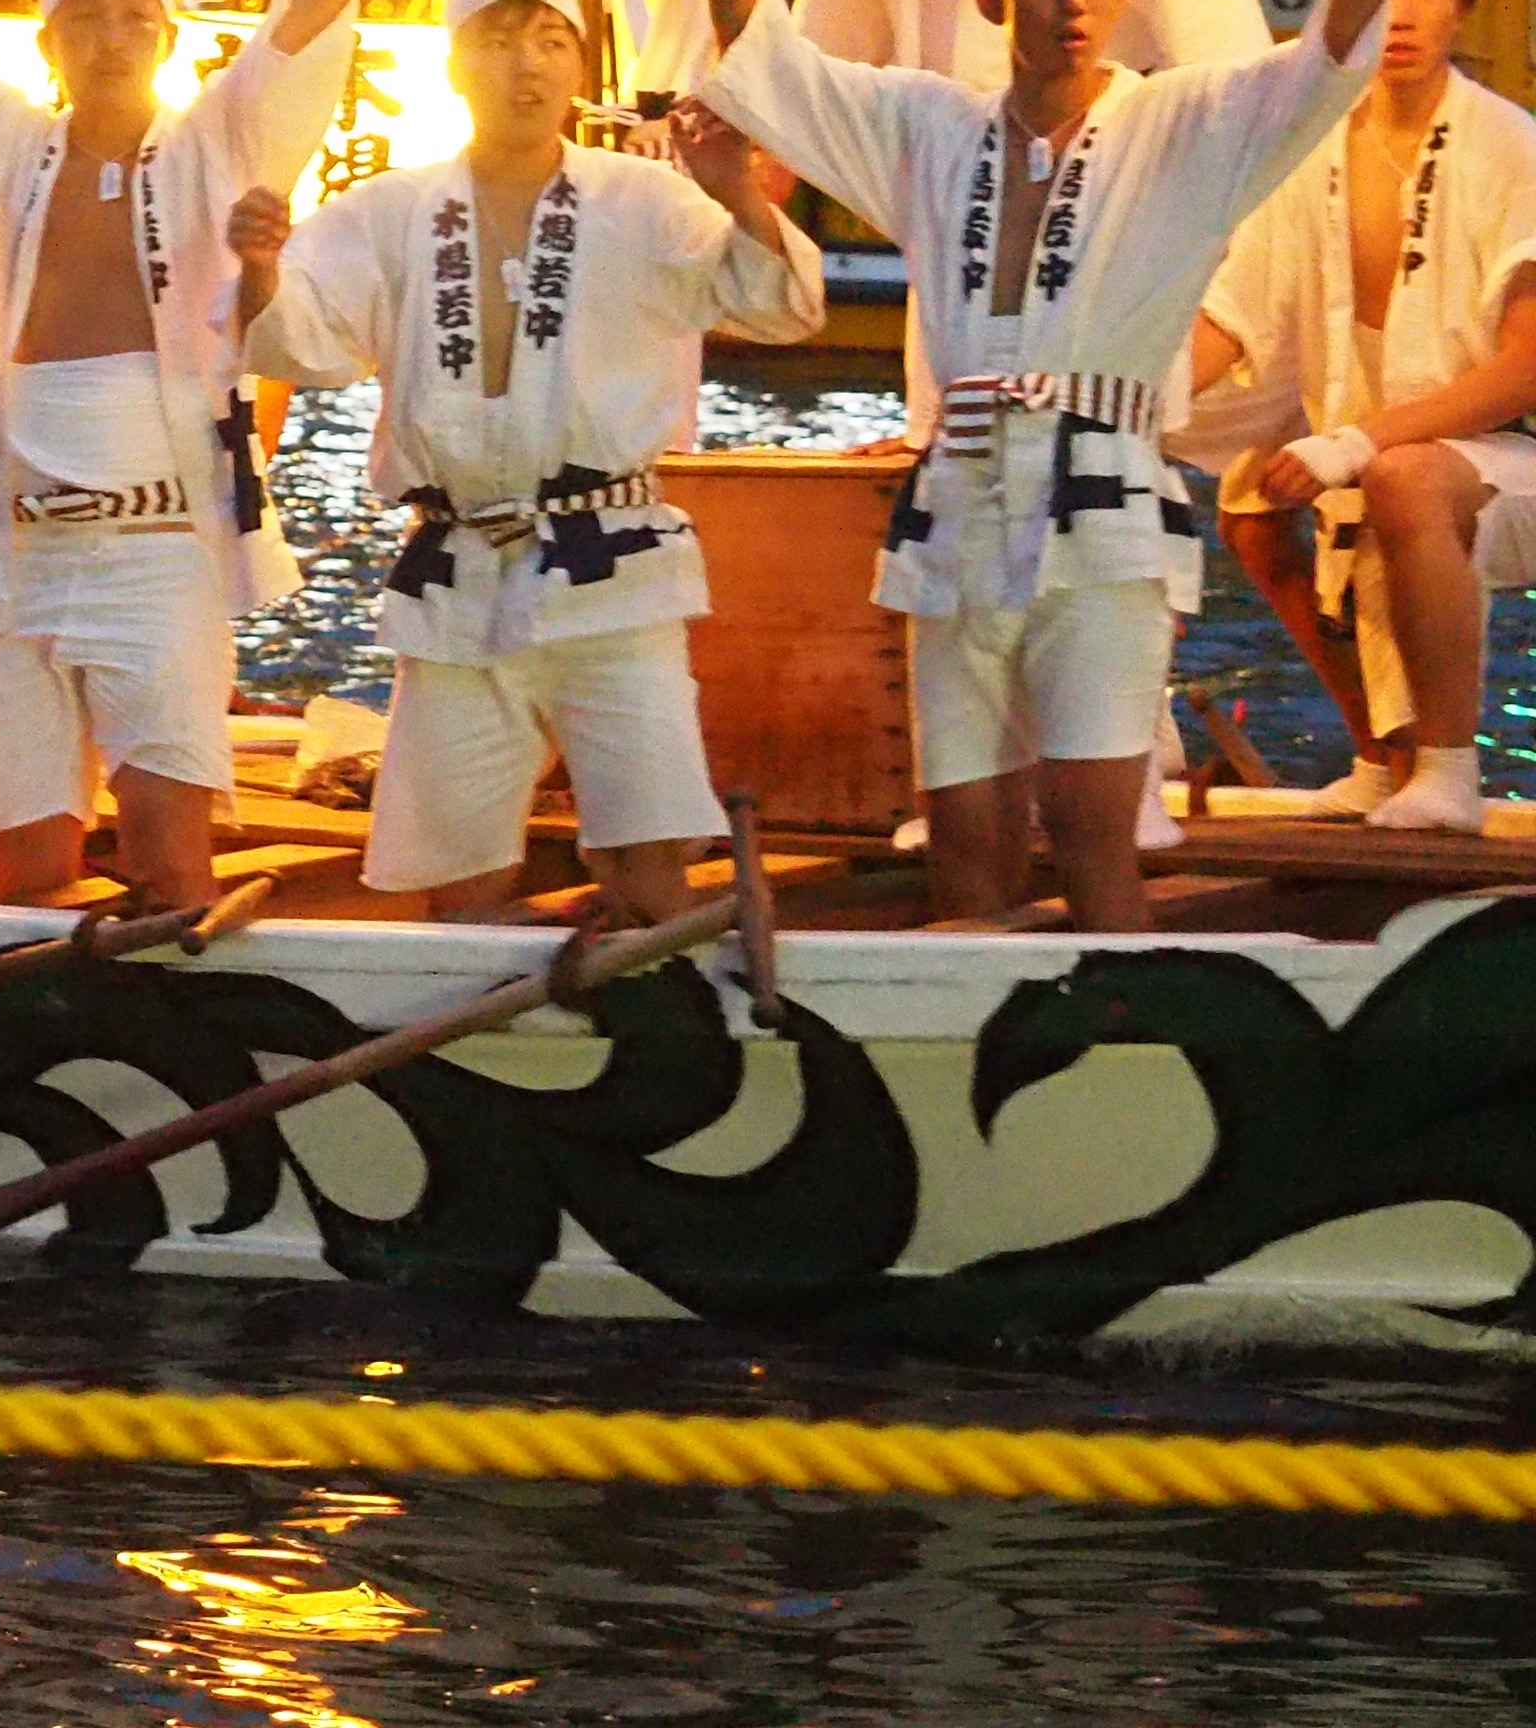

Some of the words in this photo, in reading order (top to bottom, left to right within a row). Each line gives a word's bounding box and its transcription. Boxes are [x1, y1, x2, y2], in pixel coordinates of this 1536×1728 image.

[431, 198, 474, 379] 木場若中
[525, 172, 578, 350] 木場若中
